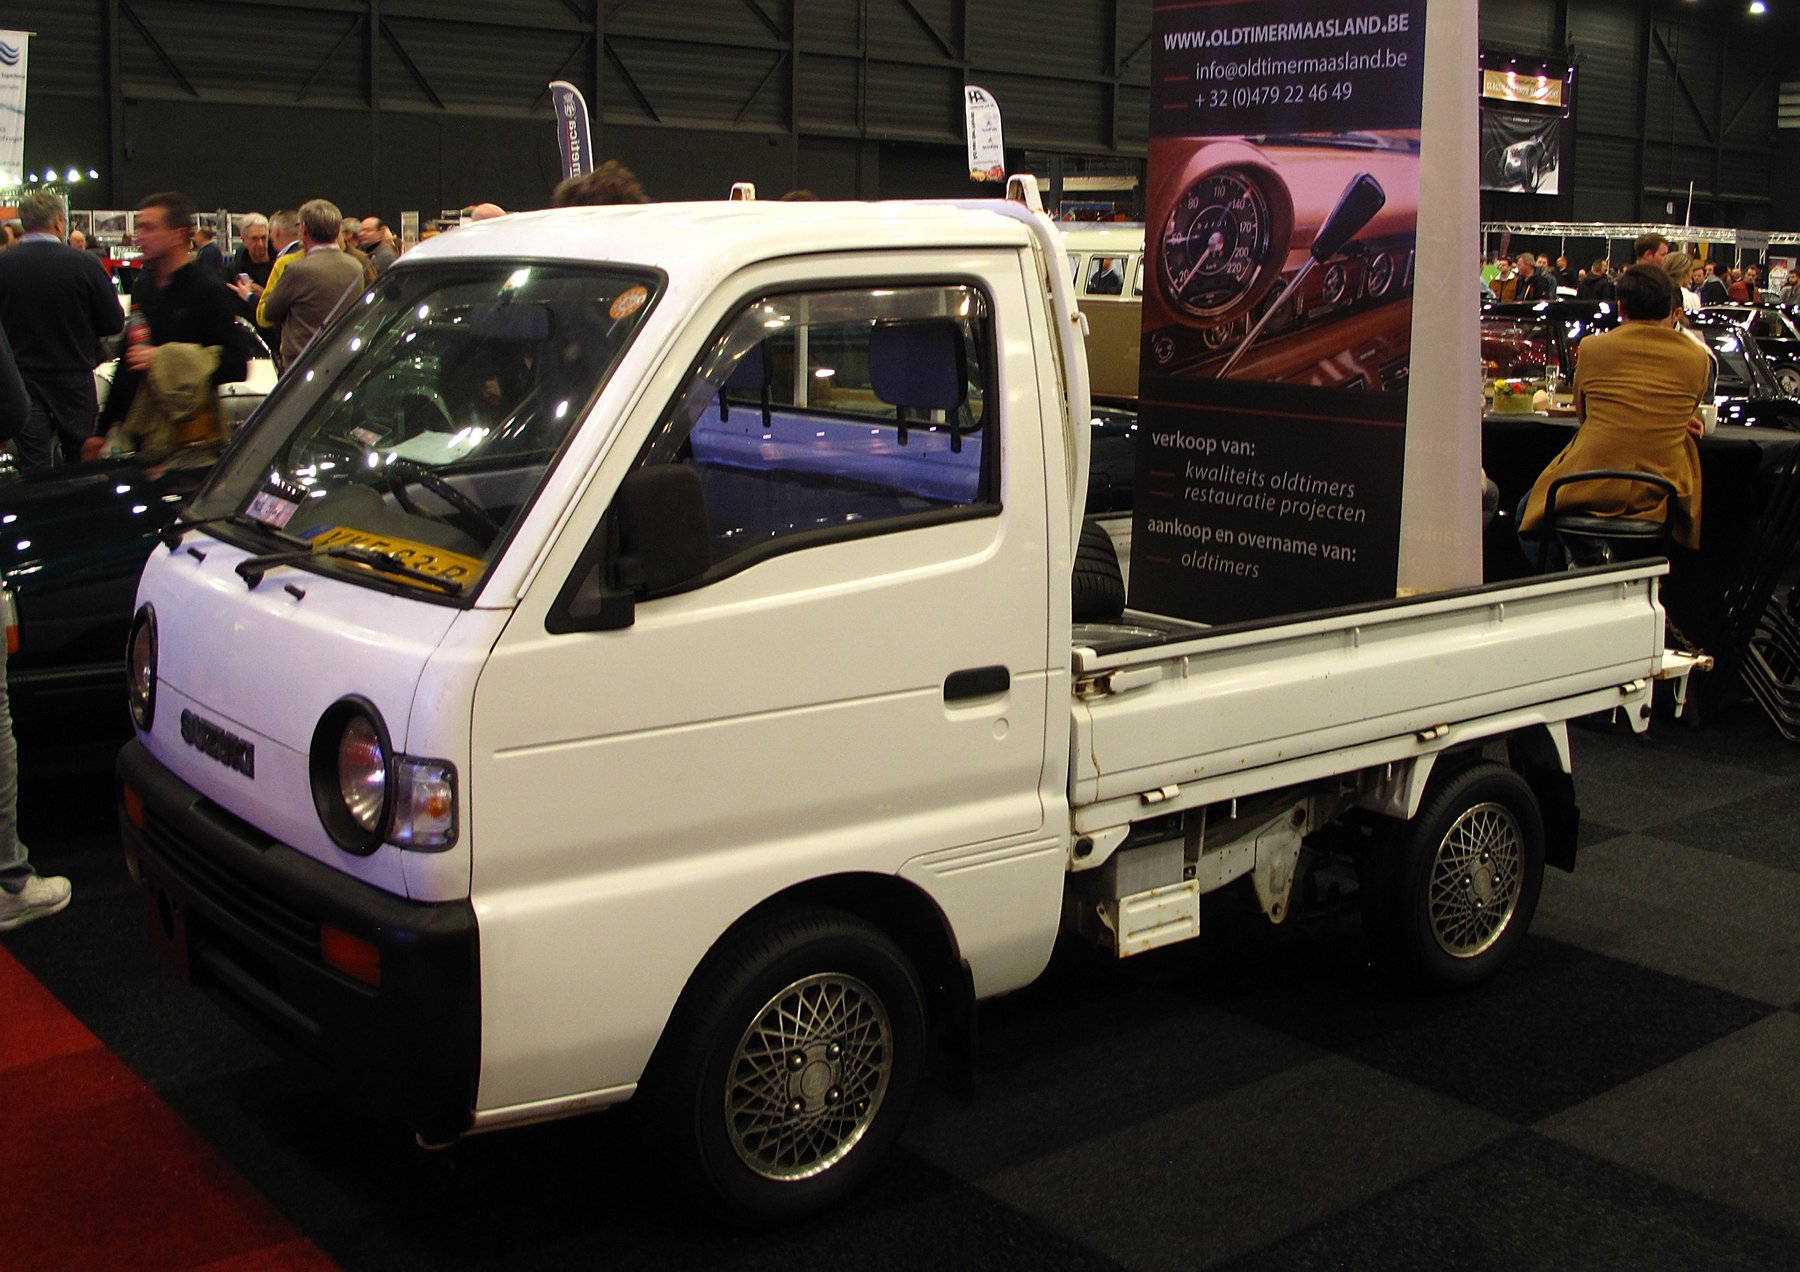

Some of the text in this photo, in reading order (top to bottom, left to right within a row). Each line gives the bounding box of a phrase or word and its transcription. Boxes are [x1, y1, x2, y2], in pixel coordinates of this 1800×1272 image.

[1164, 14, 1409, 51] WWW.OLDTIMERMAASLAND.BE
[1196, 49, 1408, 80] info@oldtimermaasland.be
[1195, 81, 1352, 109] + 32 (0)479 22 46 49
[1187, 198, 1199, 209] 80
[1214, 186, 1226, 197] 110
[1232, 199, 1246, 210] 140
[1239, 222, 1252, 233] 170
[1235, 247, 1249, 258] 200
[1179, 269, 1189, 283] 20
[1226, 263, 1241, 274] 220
[1152, 429, 1256, 456] verkoop van:
[1185, 460, 1355, 499] kwaliteits oldtimers
[1184, 485, 1366, 523] restauratie projecten
[1147, 517, 1357, 563] aankoop en overname van:
[1181, 550, 1259, 579] oldtimers
[181, 708, 255, 780] SUZUKI
